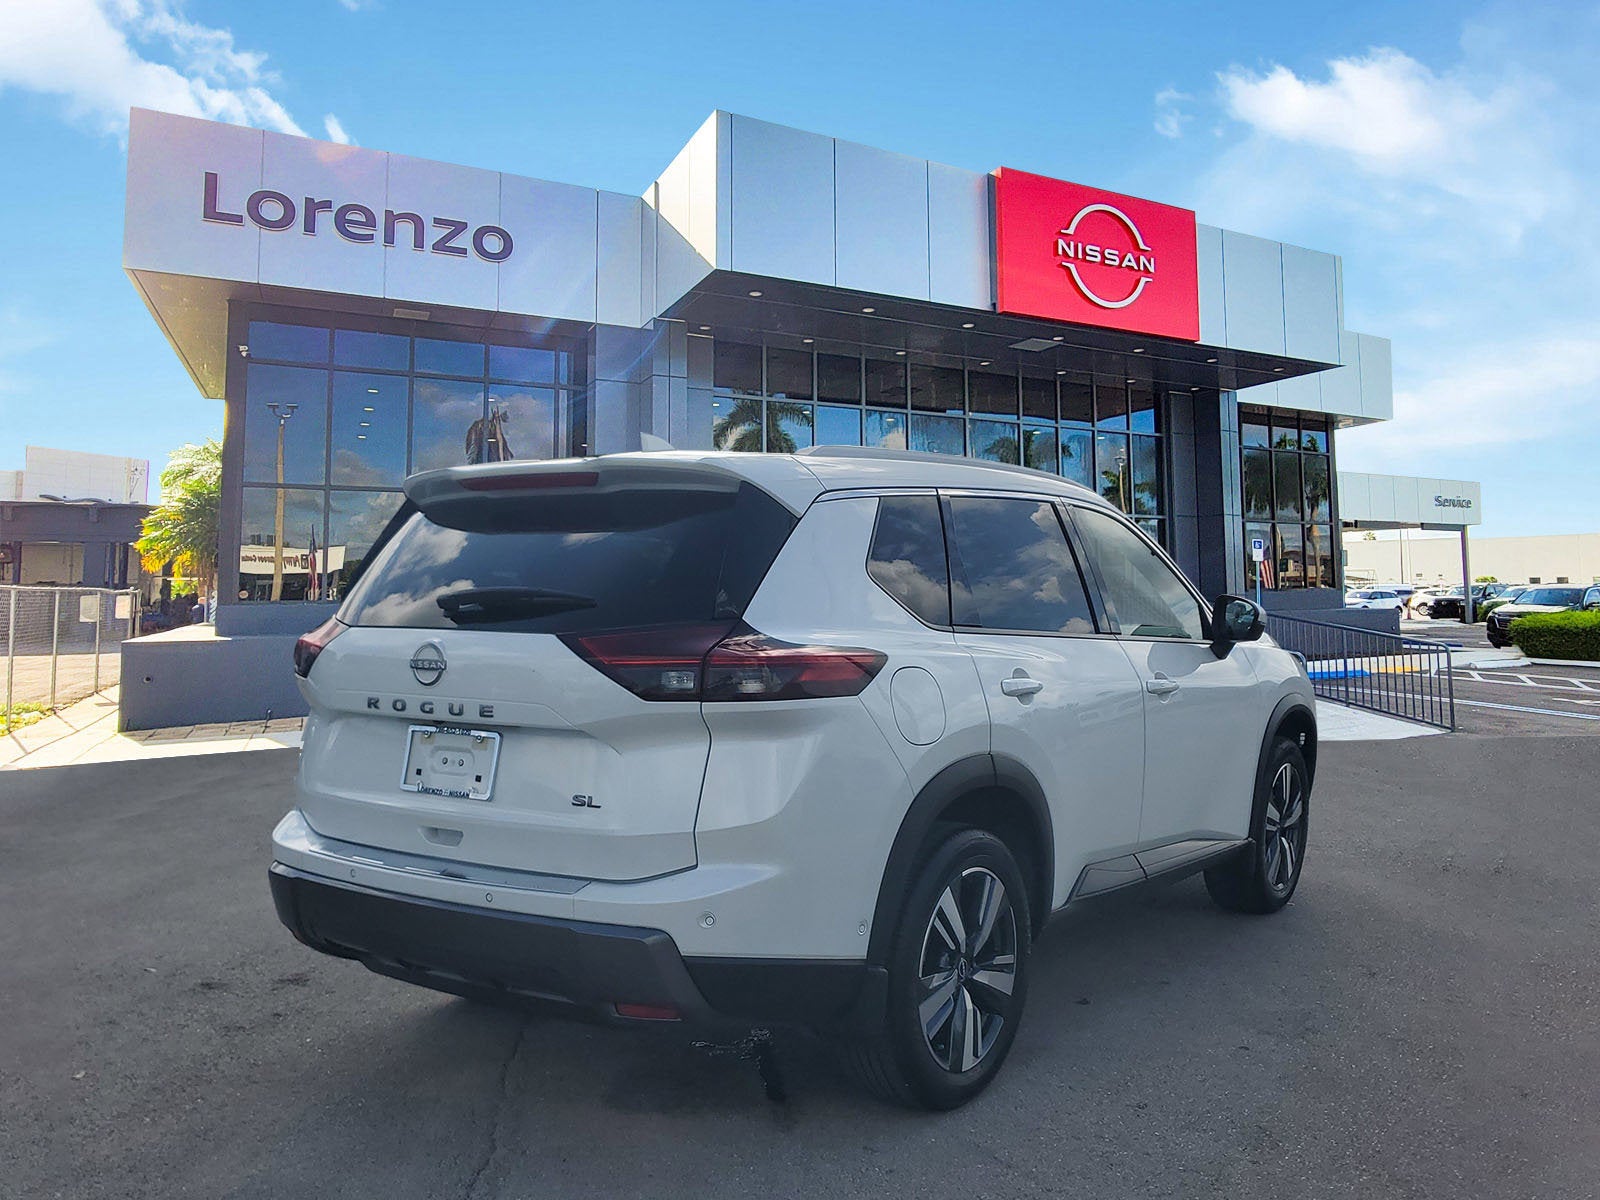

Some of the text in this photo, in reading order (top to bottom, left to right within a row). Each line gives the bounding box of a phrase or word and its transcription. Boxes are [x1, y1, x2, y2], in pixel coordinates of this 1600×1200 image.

[203, 171, 514, 262] Lorenzo
[1057, 238, 1155, 273] NISSAN
[1434, 495, 1472, 509] Service
[410, 659, 447, 670] NISSAN
[367, 697, 494, 718] ROGUE
[571, 794, 602, 809] SL
